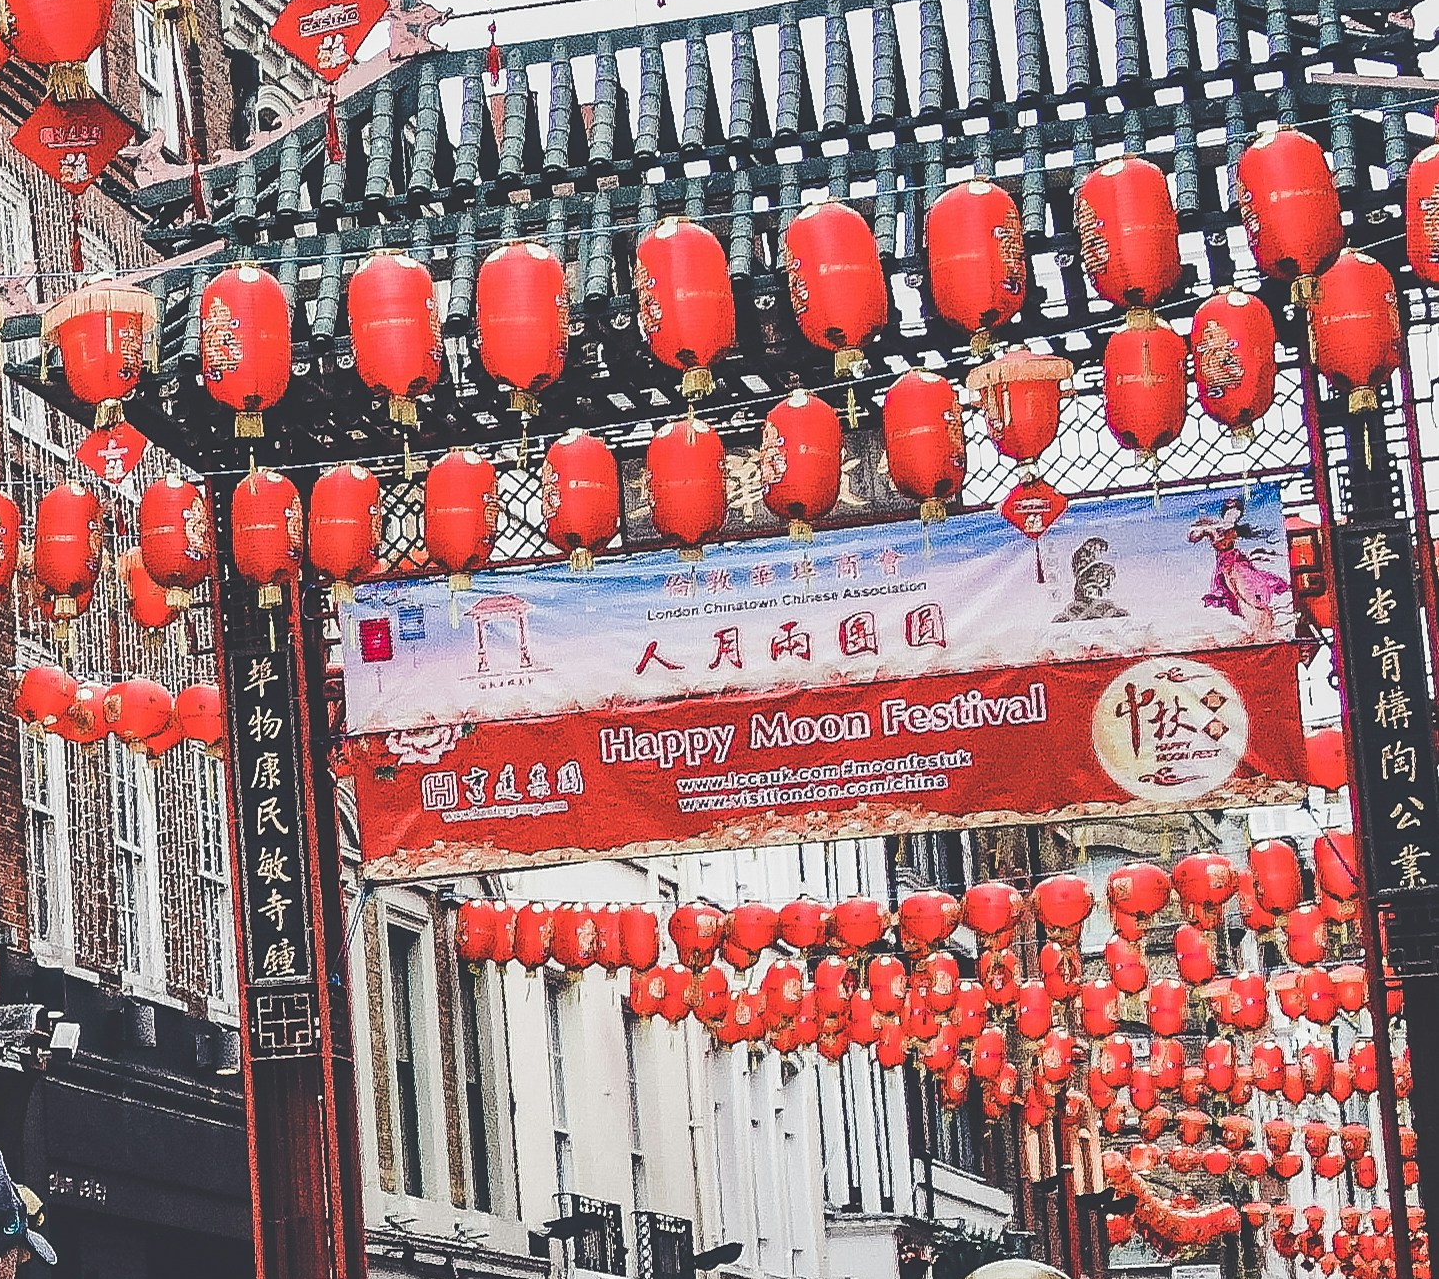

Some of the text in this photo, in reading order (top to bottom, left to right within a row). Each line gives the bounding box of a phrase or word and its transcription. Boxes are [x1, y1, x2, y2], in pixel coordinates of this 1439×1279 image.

[299, 8, 360, 33] CASINO
[646, 580, 928, 622] London Chinatown Chinese Association
[600, 683, 1048, 769] Happy Moon Festival
[1116, 682, 1198, 760] 中秋
[841, 750, 973, 779] #moonfestuk
